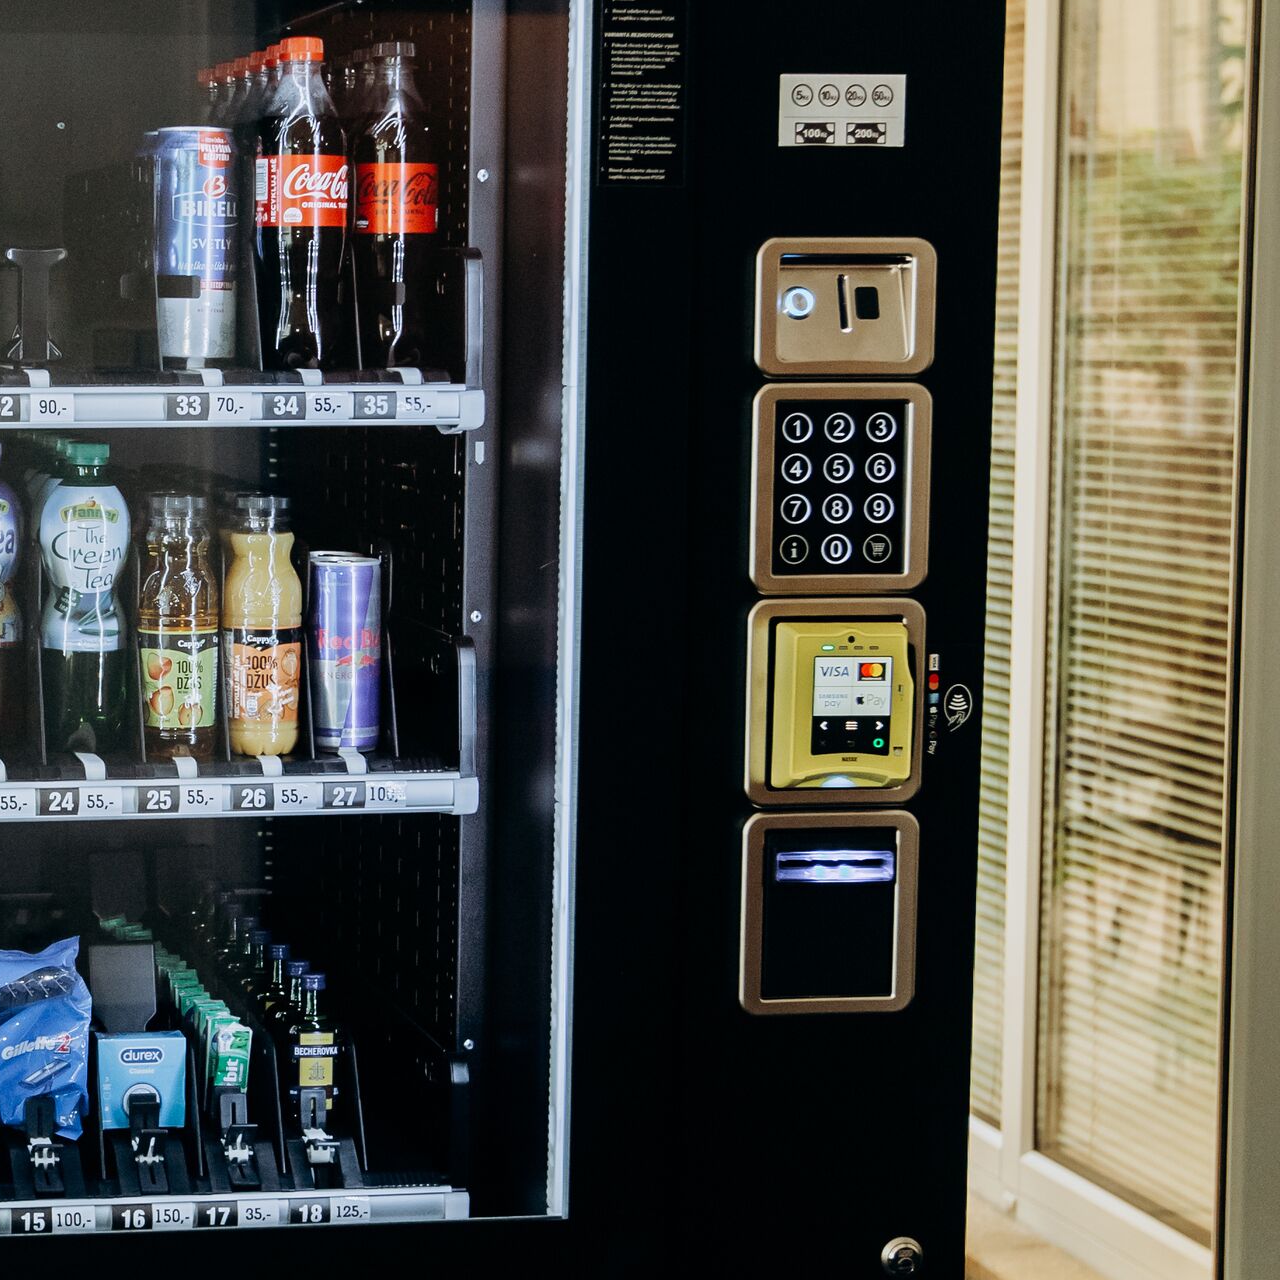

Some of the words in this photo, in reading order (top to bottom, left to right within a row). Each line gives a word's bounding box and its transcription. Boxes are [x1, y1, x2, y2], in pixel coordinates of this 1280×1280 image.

[182, 200, 237, 218] BIRELL
[39, 400, 67, 416] 90,-
[176, 395, 202, 416] 33
[217, 397, 244, 415] 70,-
[273, 395, 299, 415] 34
[314, 397, 342, 414] 55,-
[364, 395, 389, 415] 35
[405, 397, 431, 414] 55,-
[792, 419, 801, 437] 1
[832, 419, 846, 437] 2
[875, 419, 888, 437] 3
[789, 460, 803, 477] 4
[832, 459, 845, 477] 5
[873, 459, 886, 477] 6
[789, 500, 802, 518] 7
[830, 500, 844, 518] 8
[872, 499, 885, 517] 9
[77, 525, 107, 544] The
[51, 530, 122, 564] Green
[829, 540, 843, 558] 0
[74, 565, 113, 589] Tea
[177, 639, 203, 649] Cappy
[246, 634, 270, 644] Cappy
[246, 655, 278, 670] 100%
[819, 665, 850, 678] VISA
[246, 670, 276, 689] DŽUS
[824, 699, 842, 709] pay
[866, 693, 887, 708] Pay
[0, 795, 28, 812] 55,-
[48, 791, 75, 812] 24
[86, 794, 114, 810] 55,-
[146, 790, 172, 810] 25
[187, 790, 214, 806] 55,-
[241, 788, 267, 808] 26
[281, 789, 308, 805] 55,-
[332, 786, 358, 806] 27
[1, 1035, 56, 1060] Gillette
[122, 1049, 161, 1062] durex
[294, 1046, 338, 1056] BECHEROVKA
[223, 1058, 239, 1083] bit
[20, 1212, 46, 1232] 15
[56, 1212, 91, 1228] 100,-
[121, 1208, 146, 1228] 16
[155, 1208, 190, 1225] 150,-
[206, 1207, 231, 1226] 17
[245, 1208, 271, 1223] 35,-
[298, 1204, 323, 1223] 18
[336, 1205, 368, 1221] 125,-
